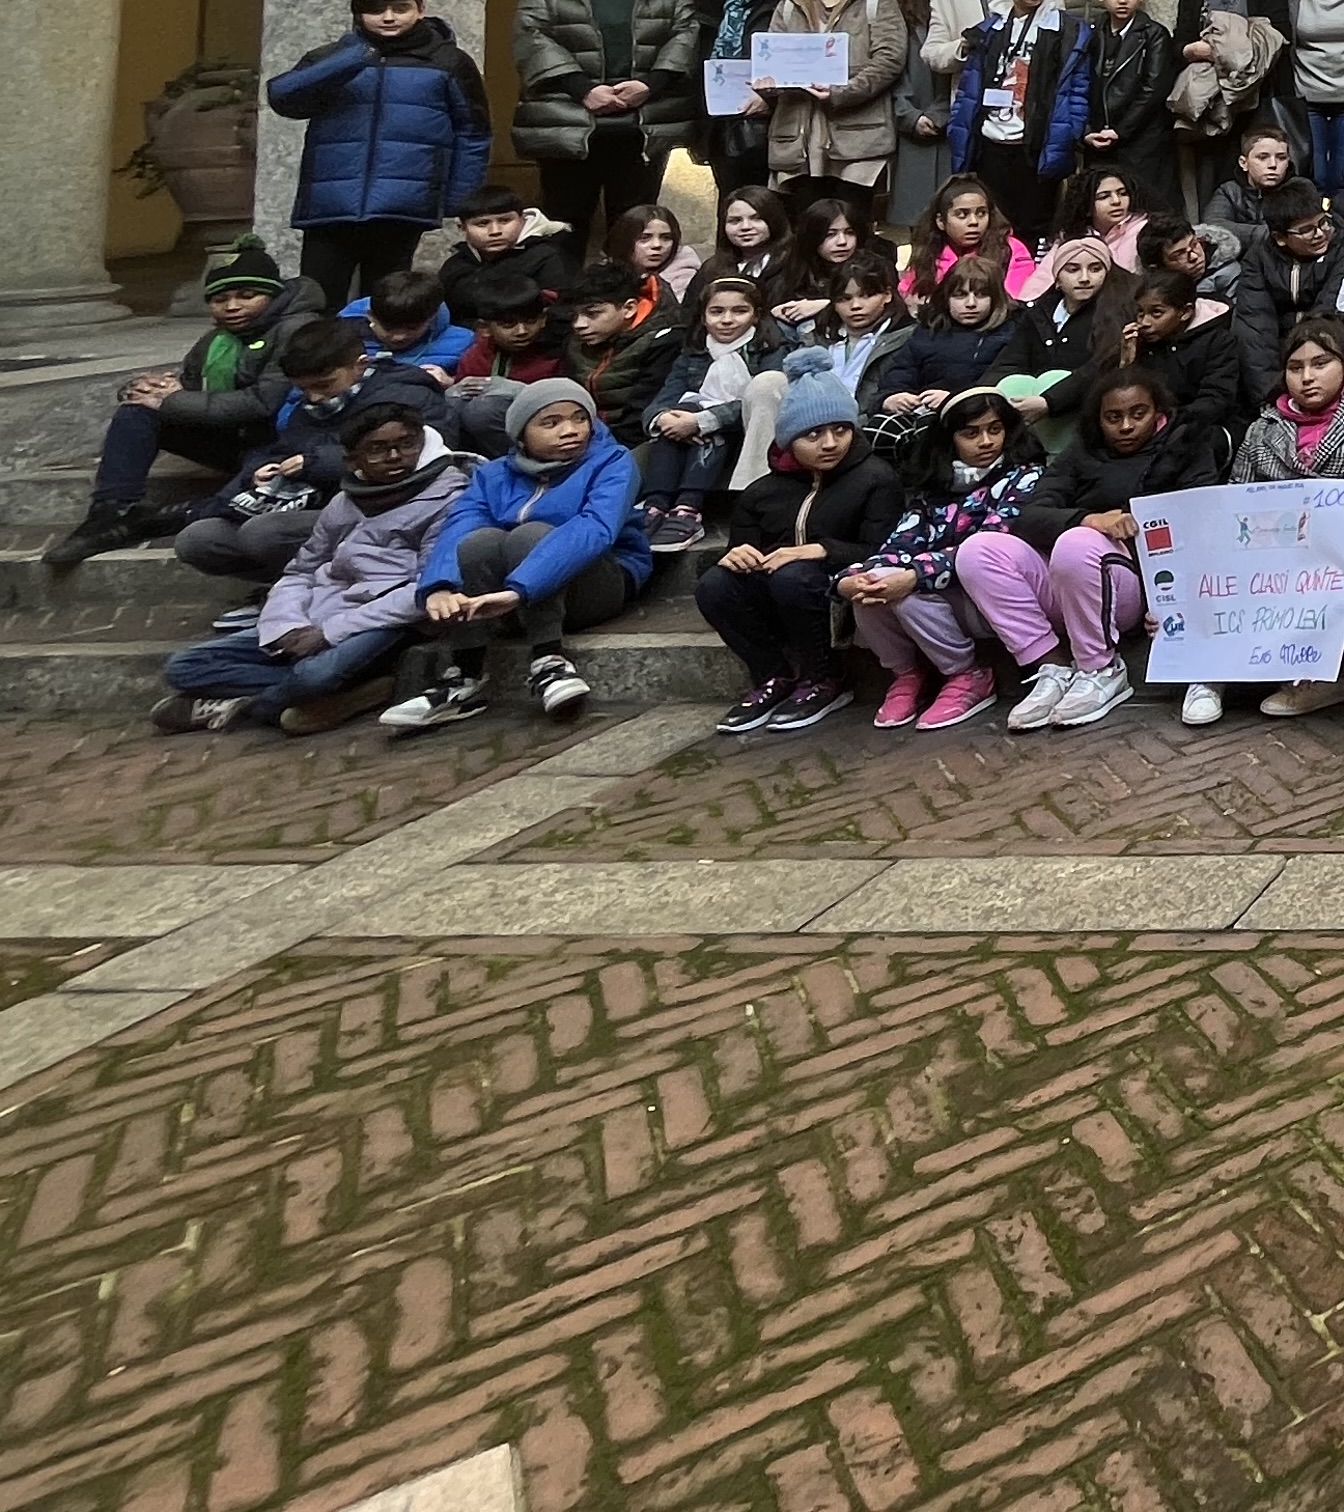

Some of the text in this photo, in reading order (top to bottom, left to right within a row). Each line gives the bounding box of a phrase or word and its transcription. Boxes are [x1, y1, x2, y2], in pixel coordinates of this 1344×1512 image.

[1143, 518, 1168, 528] CGIL
[1199, 566, 1344, 598] ALLE CLASSI QUINTE
[1156, 594, 1176, 603] CISL
[1213, 604, 1328, 635] ICS PRIMO LEVI
